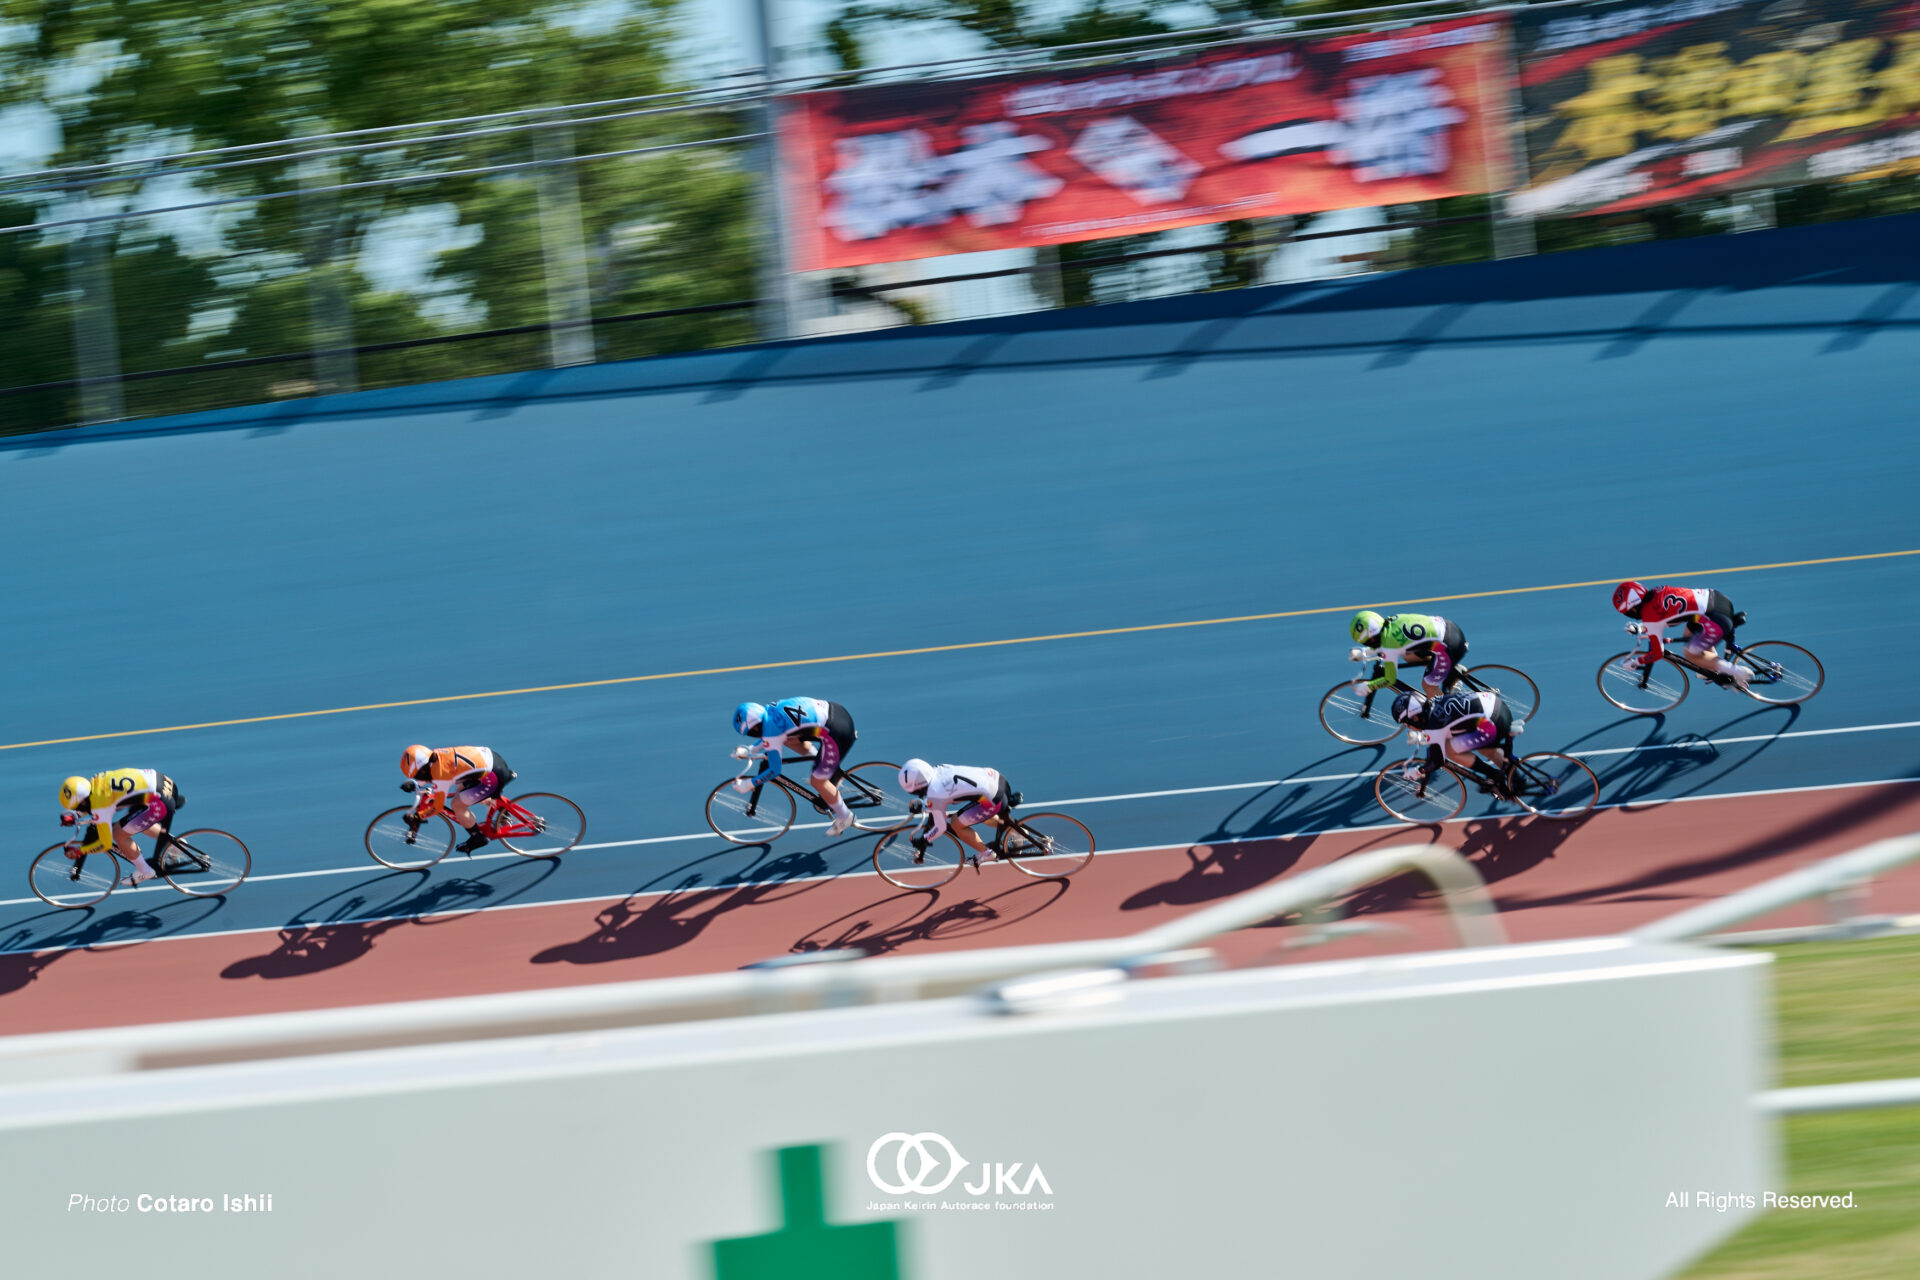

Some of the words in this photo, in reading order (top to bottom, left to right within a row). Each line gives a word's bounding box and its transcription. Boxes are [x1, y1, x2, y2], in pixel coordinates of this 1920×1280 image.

[1663, 593, 1687, 615] 3
[1402, 623, 1427, 642] 6
[783, 704, 808, 728] 4
[1443, 697, 1471, 717] 2
[453, 752, 476, 769] 7
[111, 777, 135, 795] 5
[903, 769, 908, 784] 1
